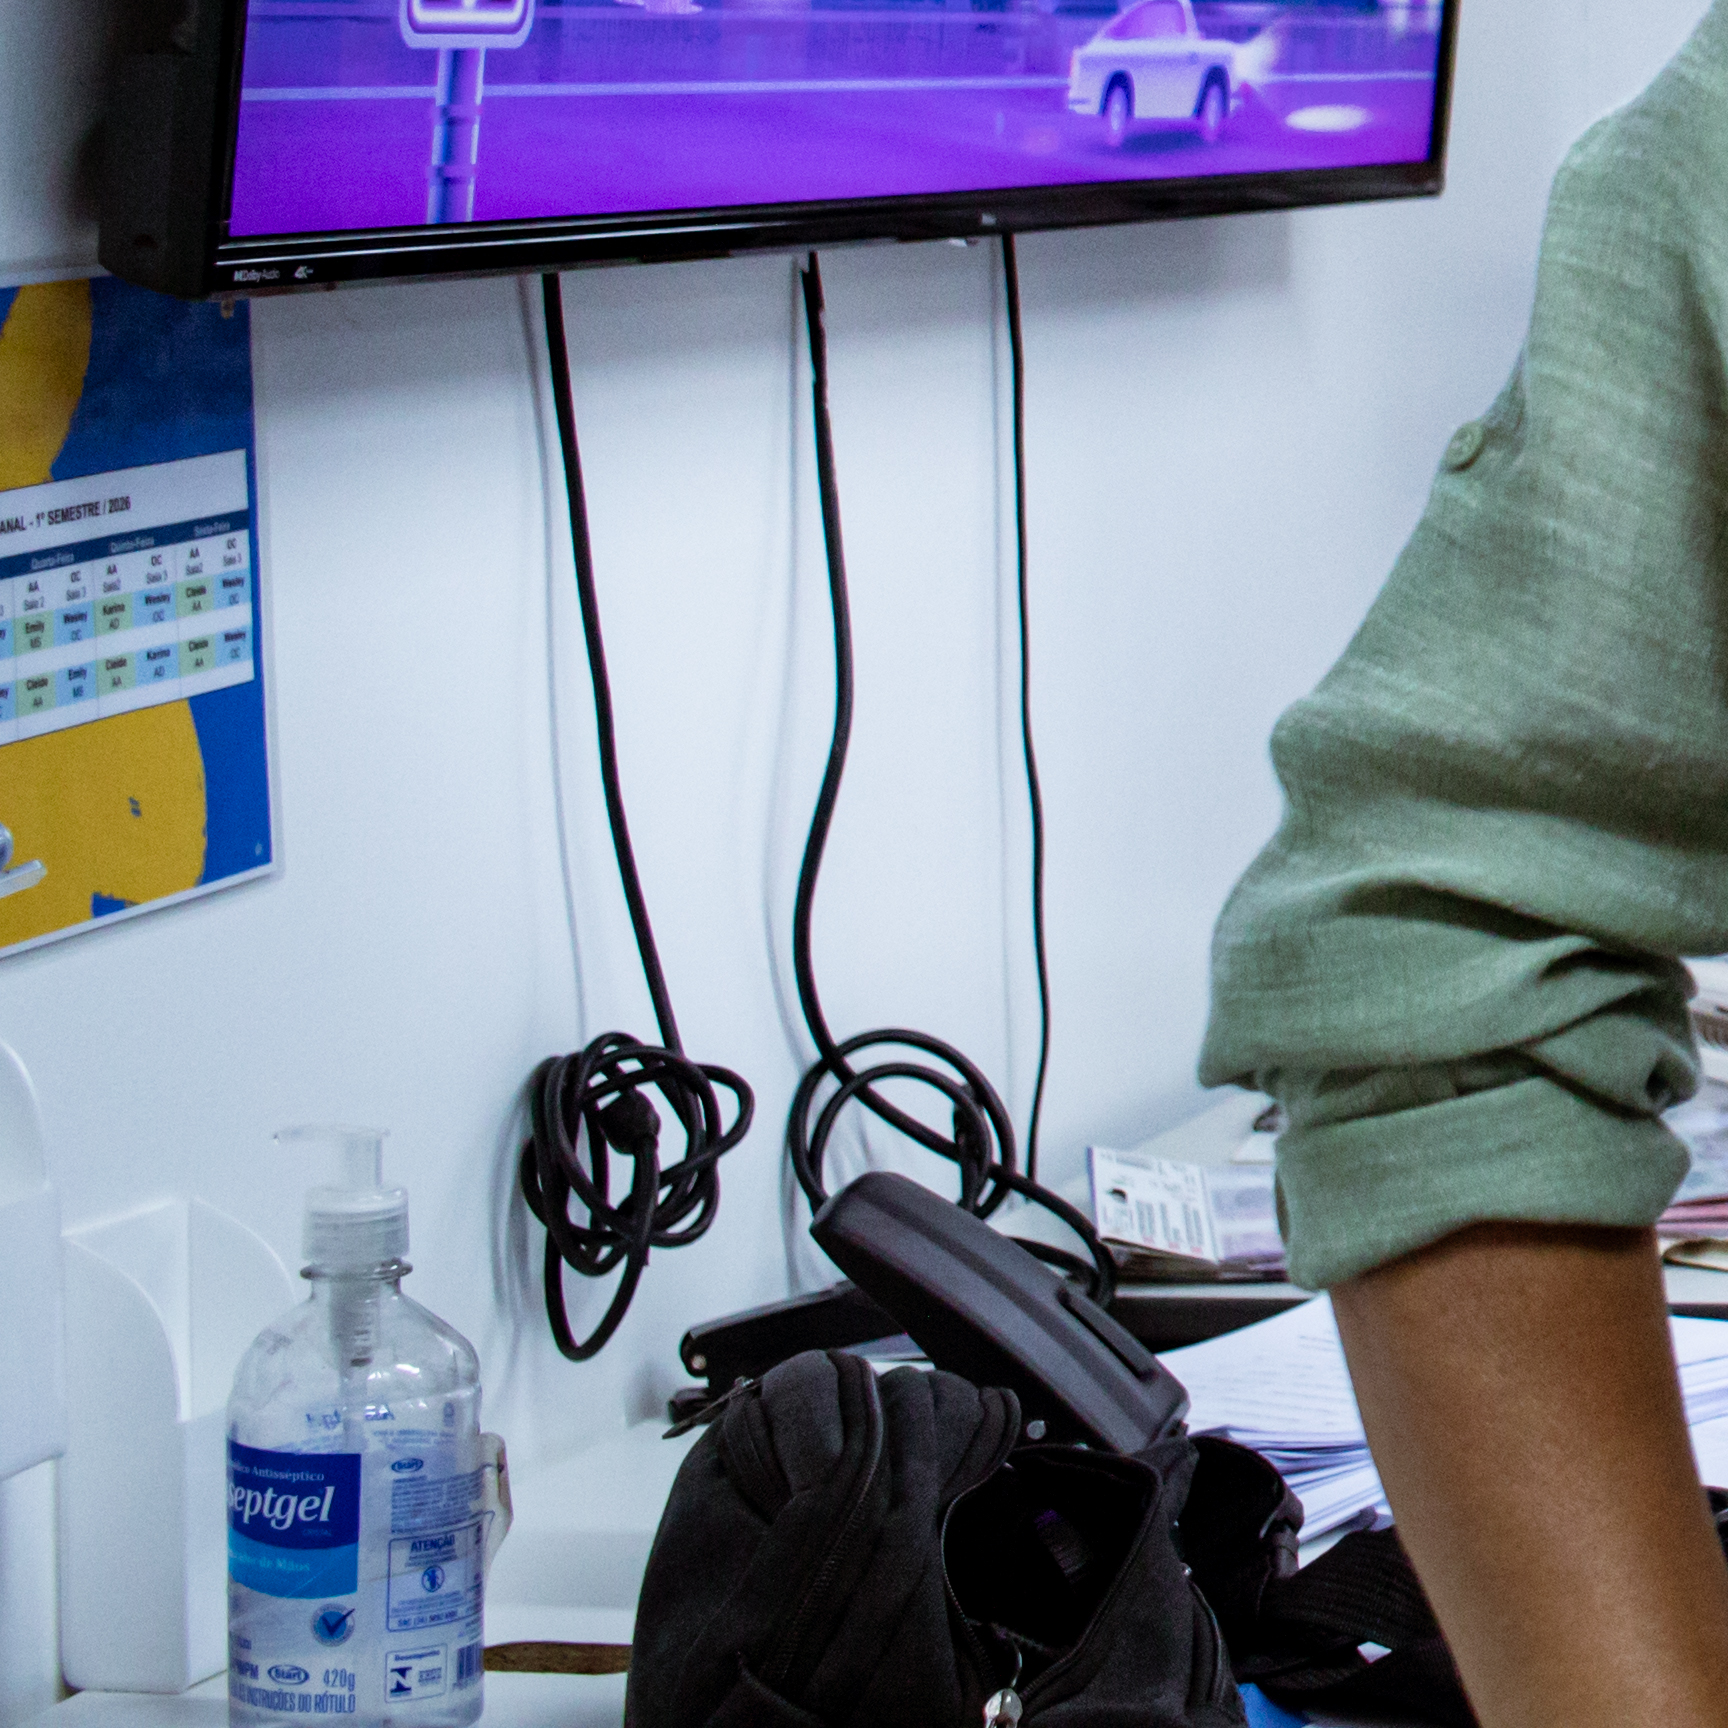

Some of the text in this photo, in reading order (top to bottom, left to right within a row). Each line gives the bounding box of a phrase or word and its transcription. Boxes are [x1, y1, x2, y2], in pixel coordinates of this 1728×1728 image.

[47, 501, 101, 526] SEMESTRE
[107, 496, 131, 513] 2026
[252, 1465, 325, 1484] Antisséptico
[411, 1534, 455, 1552] ATENÇÃO
[323, 1668, 356, 1692] 420g
[299, 1693, 312, 1713] DO
[315, 1689, 356, 1713] RÓTULO
